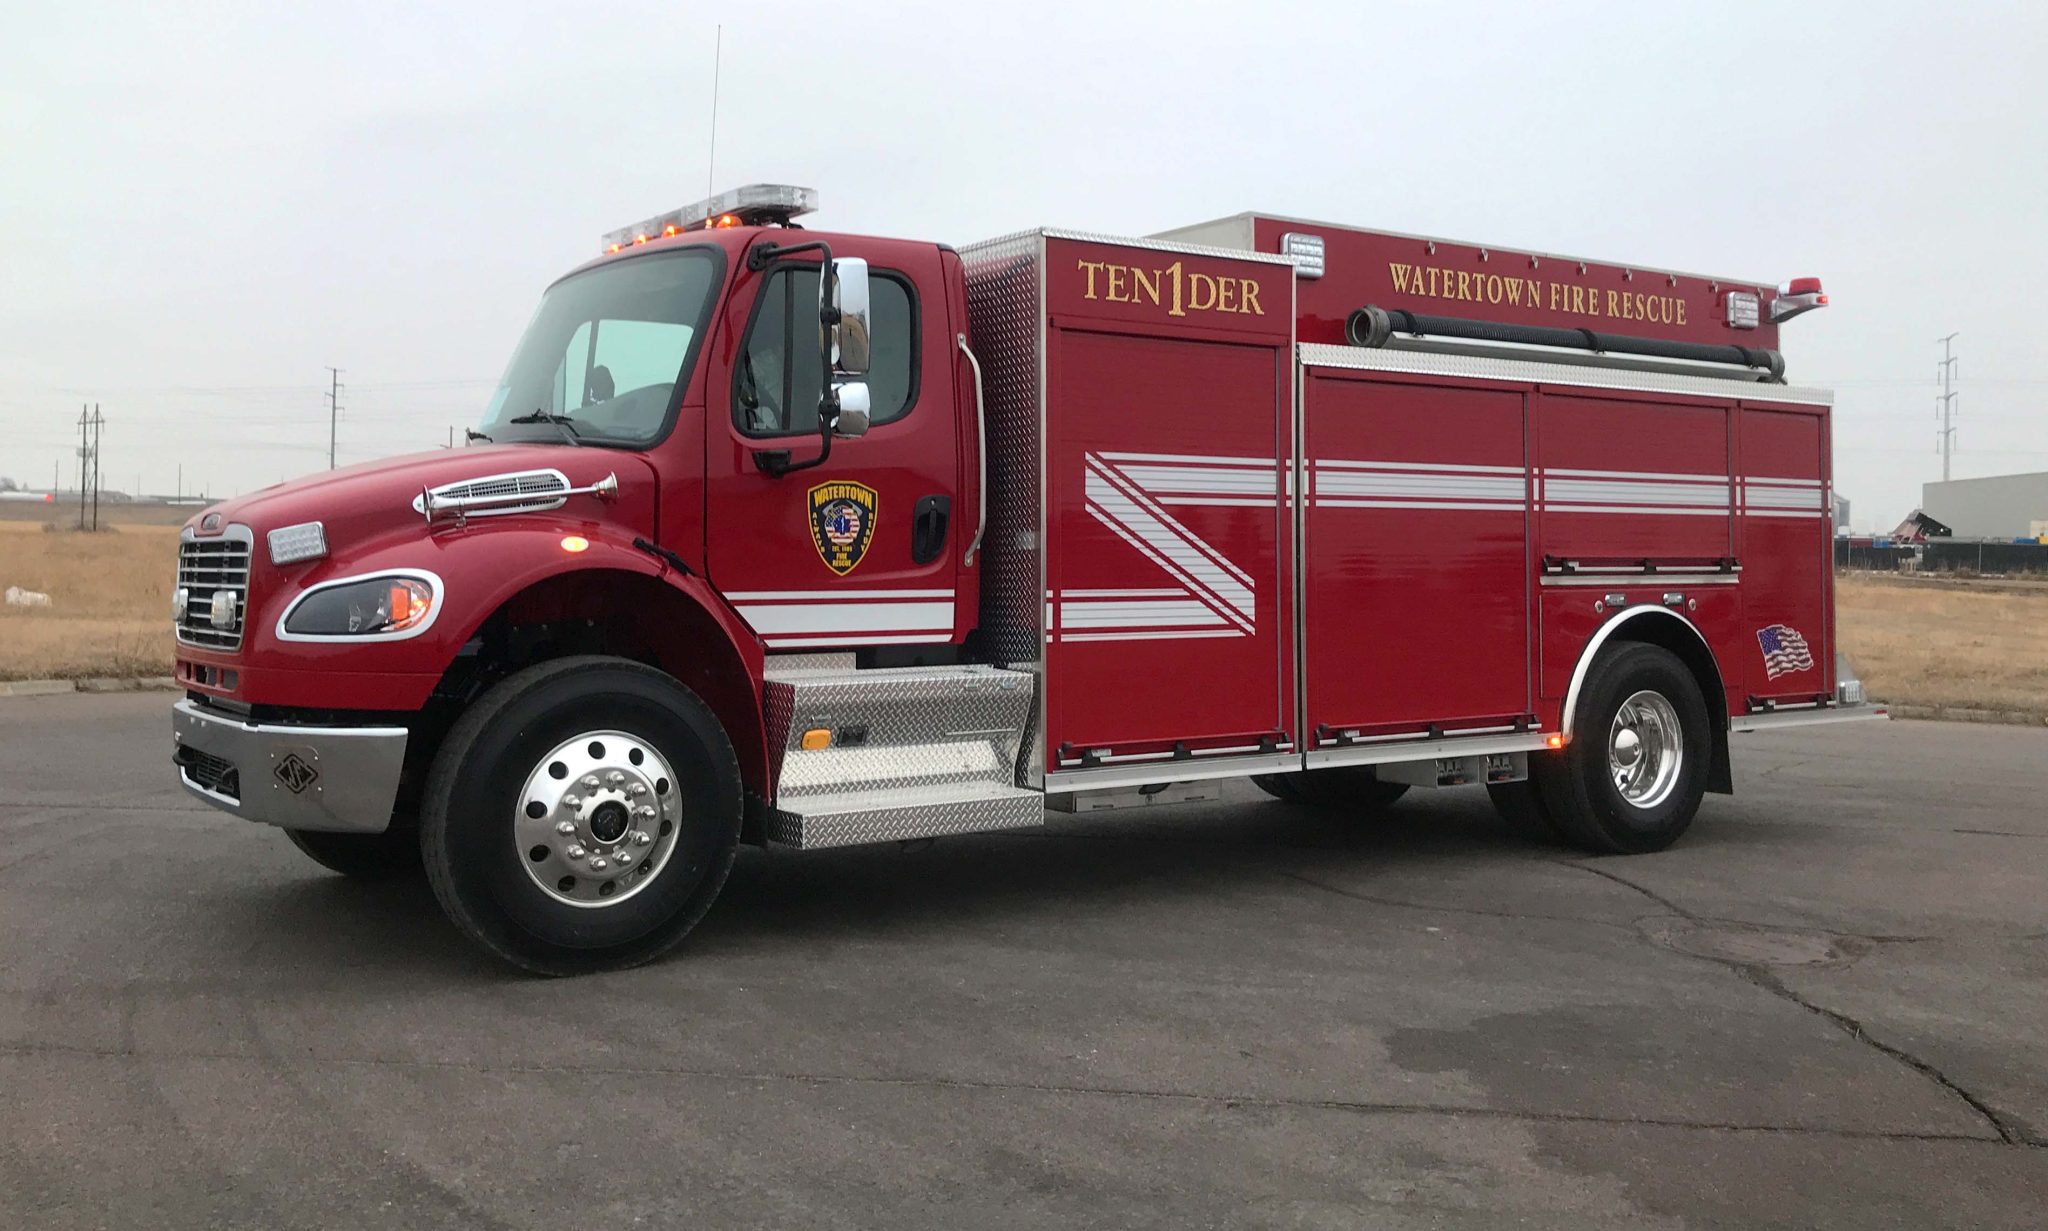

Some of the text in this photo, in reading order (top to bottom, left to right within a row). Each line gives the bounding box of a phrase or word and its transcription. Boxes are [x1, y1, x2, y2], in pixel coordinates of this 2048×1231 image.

[1078, 259, 1265, 317] TEN1DER
[1388, 262, 1687, 325] WATERTOWN FIRE RESCUE
[814, 485, 872, 510] WATERTOWN
